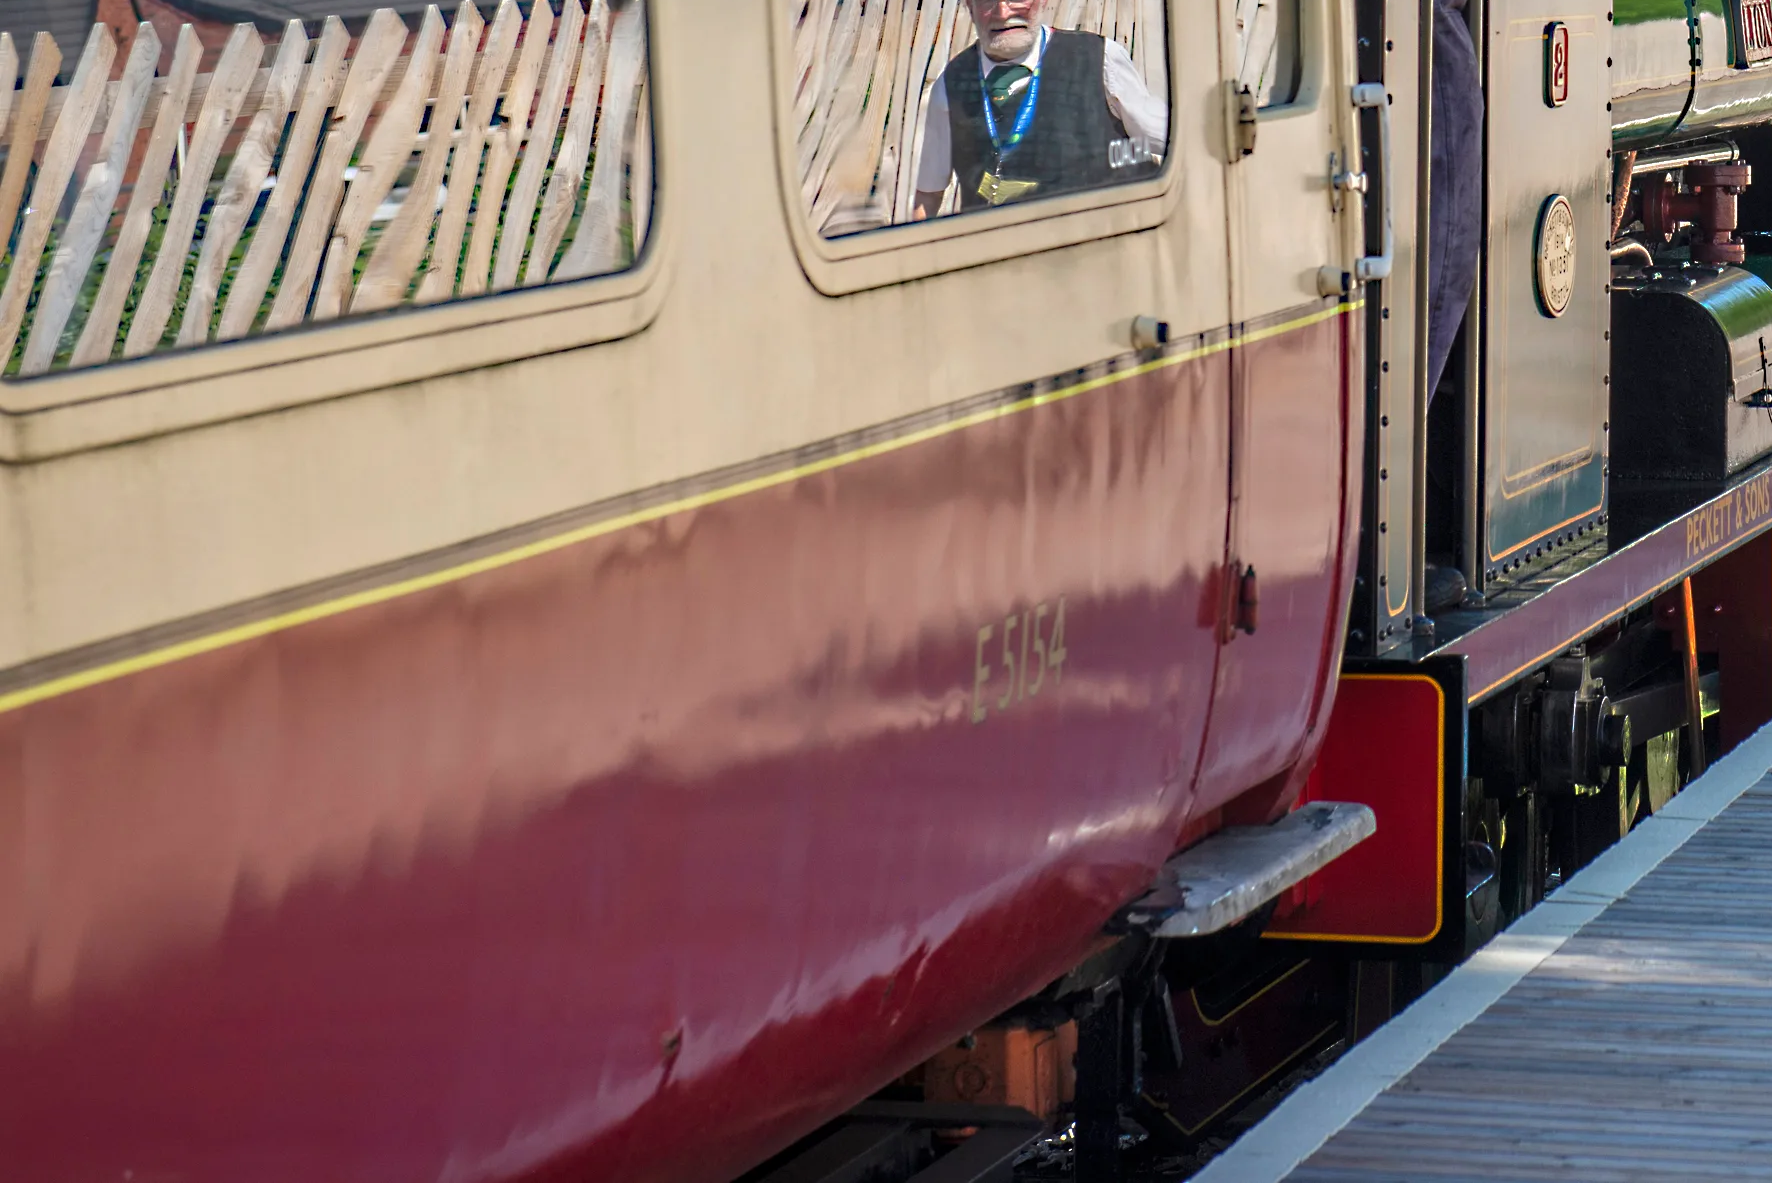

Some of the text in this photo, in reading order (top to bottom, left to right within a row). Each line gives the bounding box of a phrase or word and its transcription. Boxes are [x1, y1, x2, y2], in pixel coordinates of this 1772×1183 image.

[1553, 41, 1565, 87] 2
[1686, 494, 1733, 559] PECKETT
[1735, 490, 1743, 531] &
[1745, 475, 1770, 524] SONS
